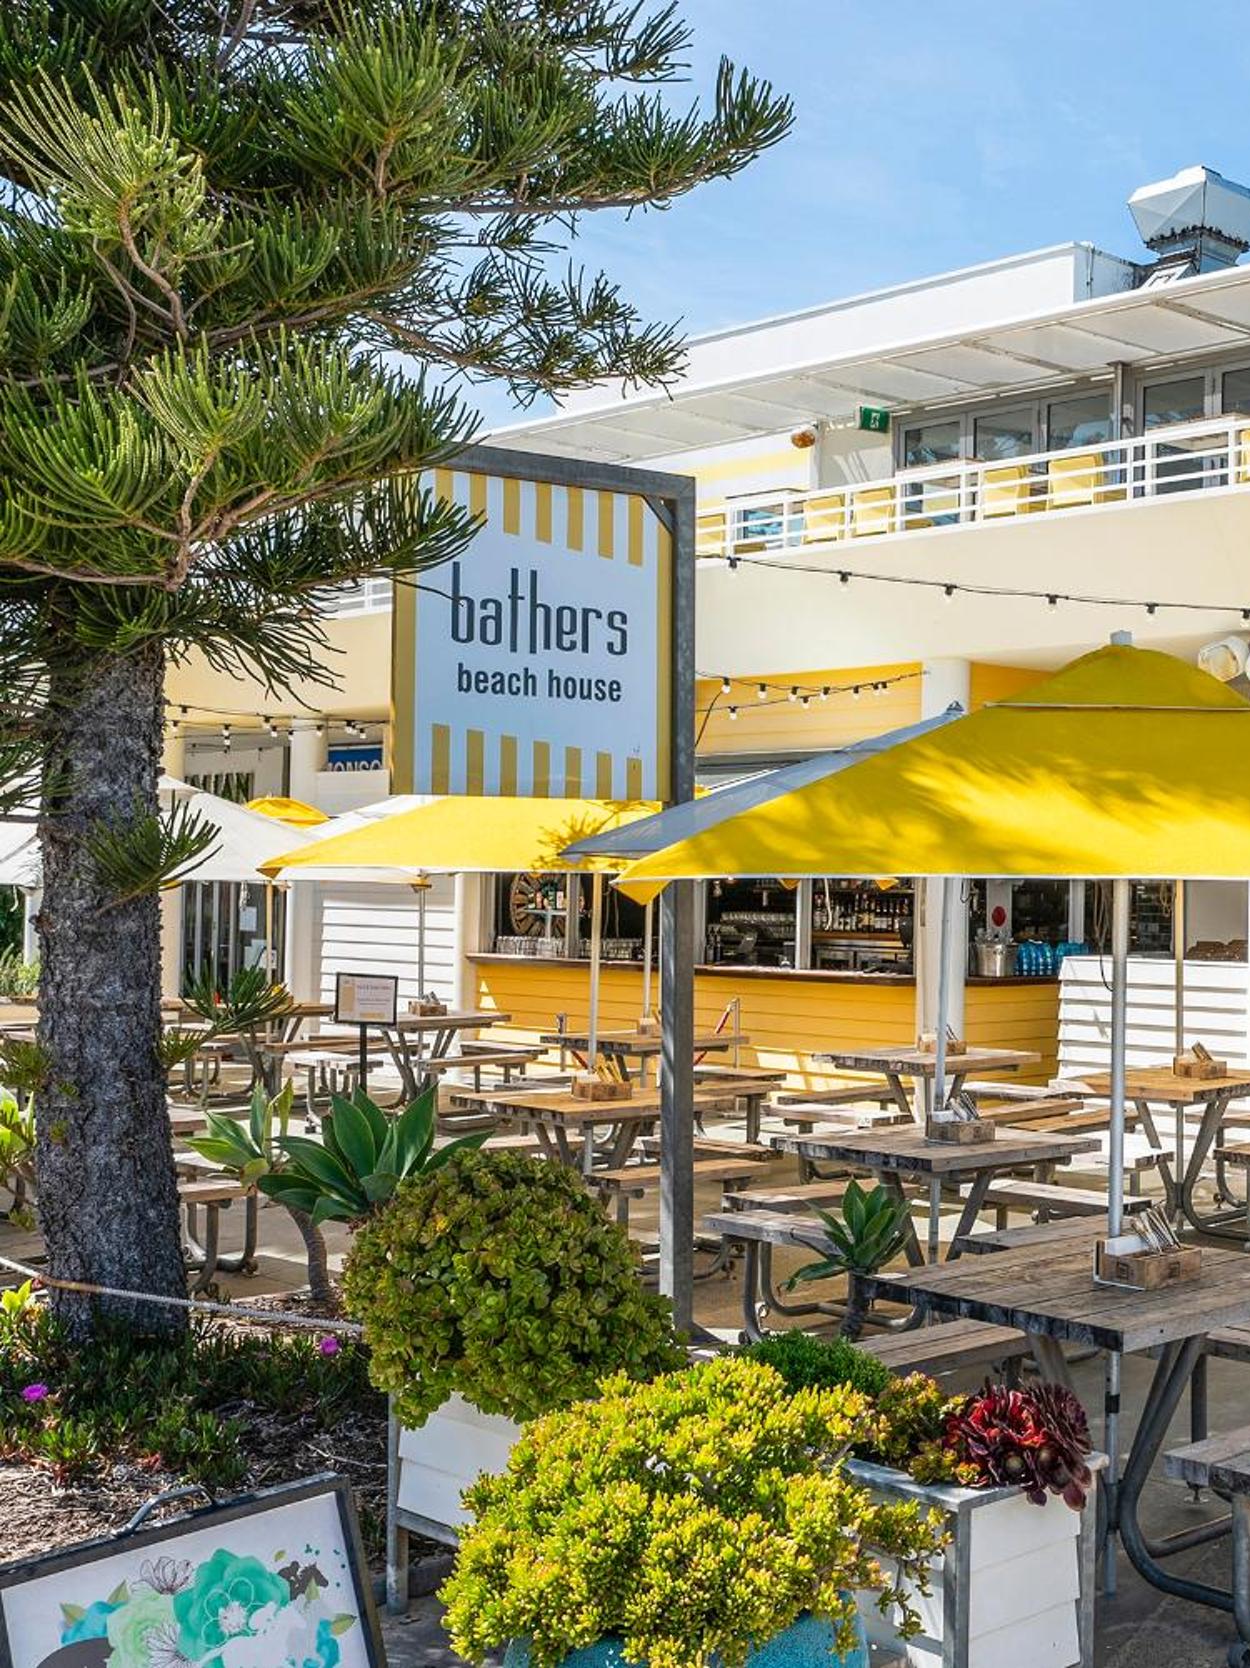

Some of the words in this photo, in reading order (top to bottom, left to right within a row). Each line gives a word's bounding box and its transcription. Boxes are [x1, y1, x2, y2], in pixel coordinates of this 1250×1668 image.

[450, 560, 628, 656] bathers
[457, 662, 537, 697] beach
[547, 668, 622, 703] house
